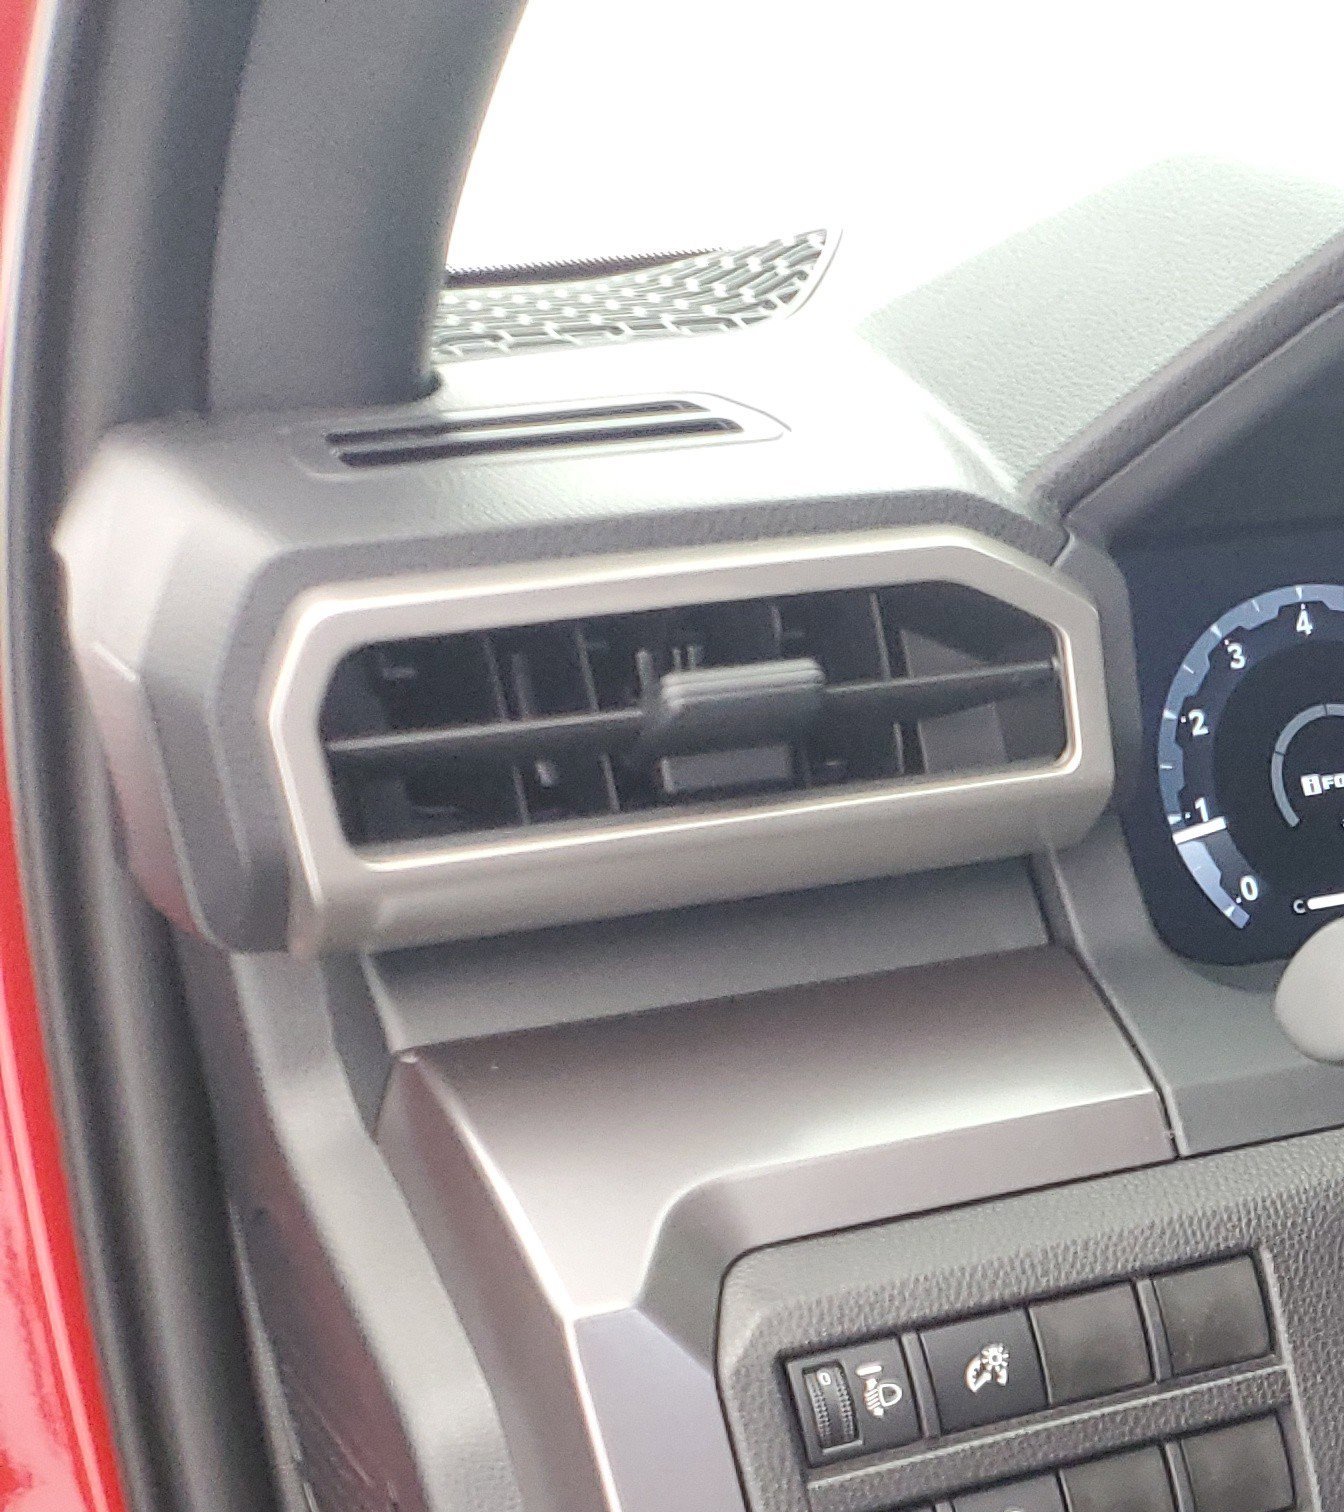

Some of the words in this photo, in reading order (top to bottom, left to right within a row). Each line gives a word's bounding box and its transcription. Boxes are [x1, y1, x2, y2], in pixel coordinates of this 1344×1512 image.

[1296, 611, 1313, 636] 4
[1228, 643, 1246, 669] 3
[1189, 711, 1209, 736] 2
[1195, 799, 1209, 821] 1
[1239, 877, 1259, 901] 0
[1293, 899, 1306, 914] C
